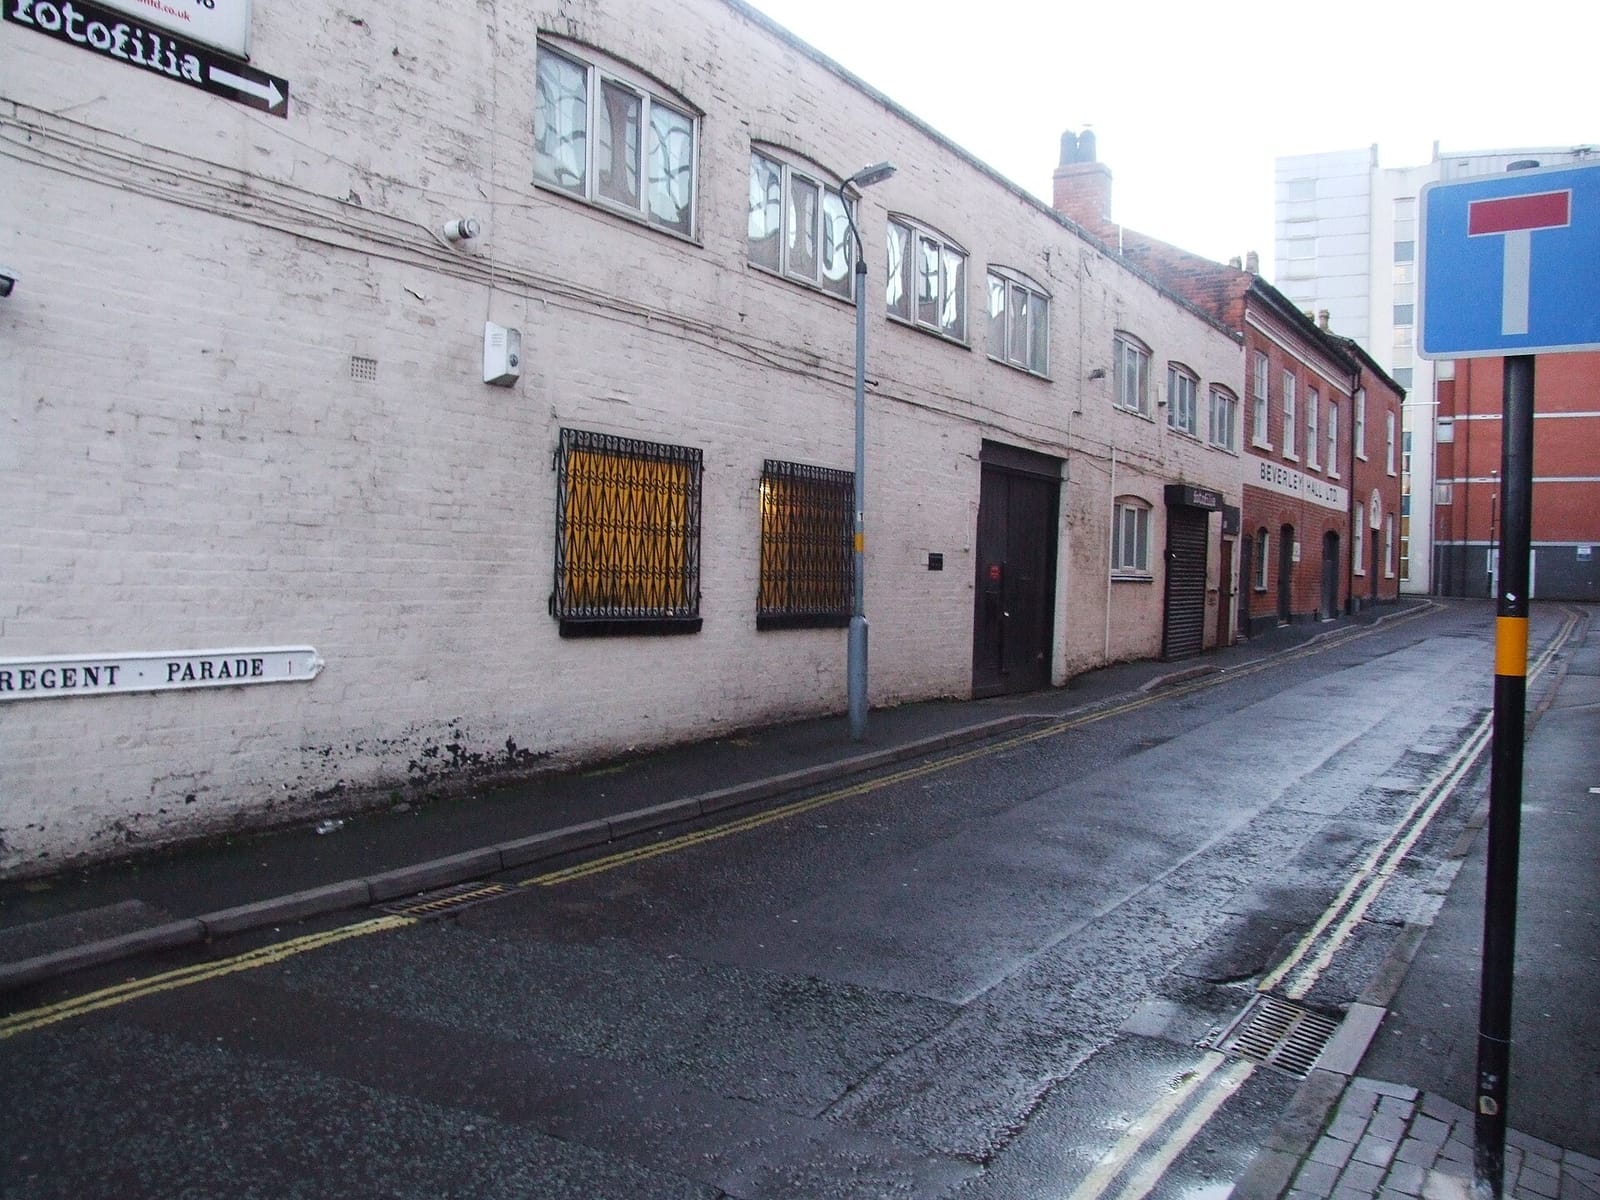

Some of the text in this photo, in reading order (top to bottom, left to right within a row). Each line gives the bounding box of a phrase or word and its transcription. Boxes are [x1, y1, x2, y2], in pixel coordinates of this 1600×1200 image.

[1260, 462, 1304, 491] BEVERLEY
[0, 666, 120, 691] REGENT
[167, 658, 264, 682] PARADE
